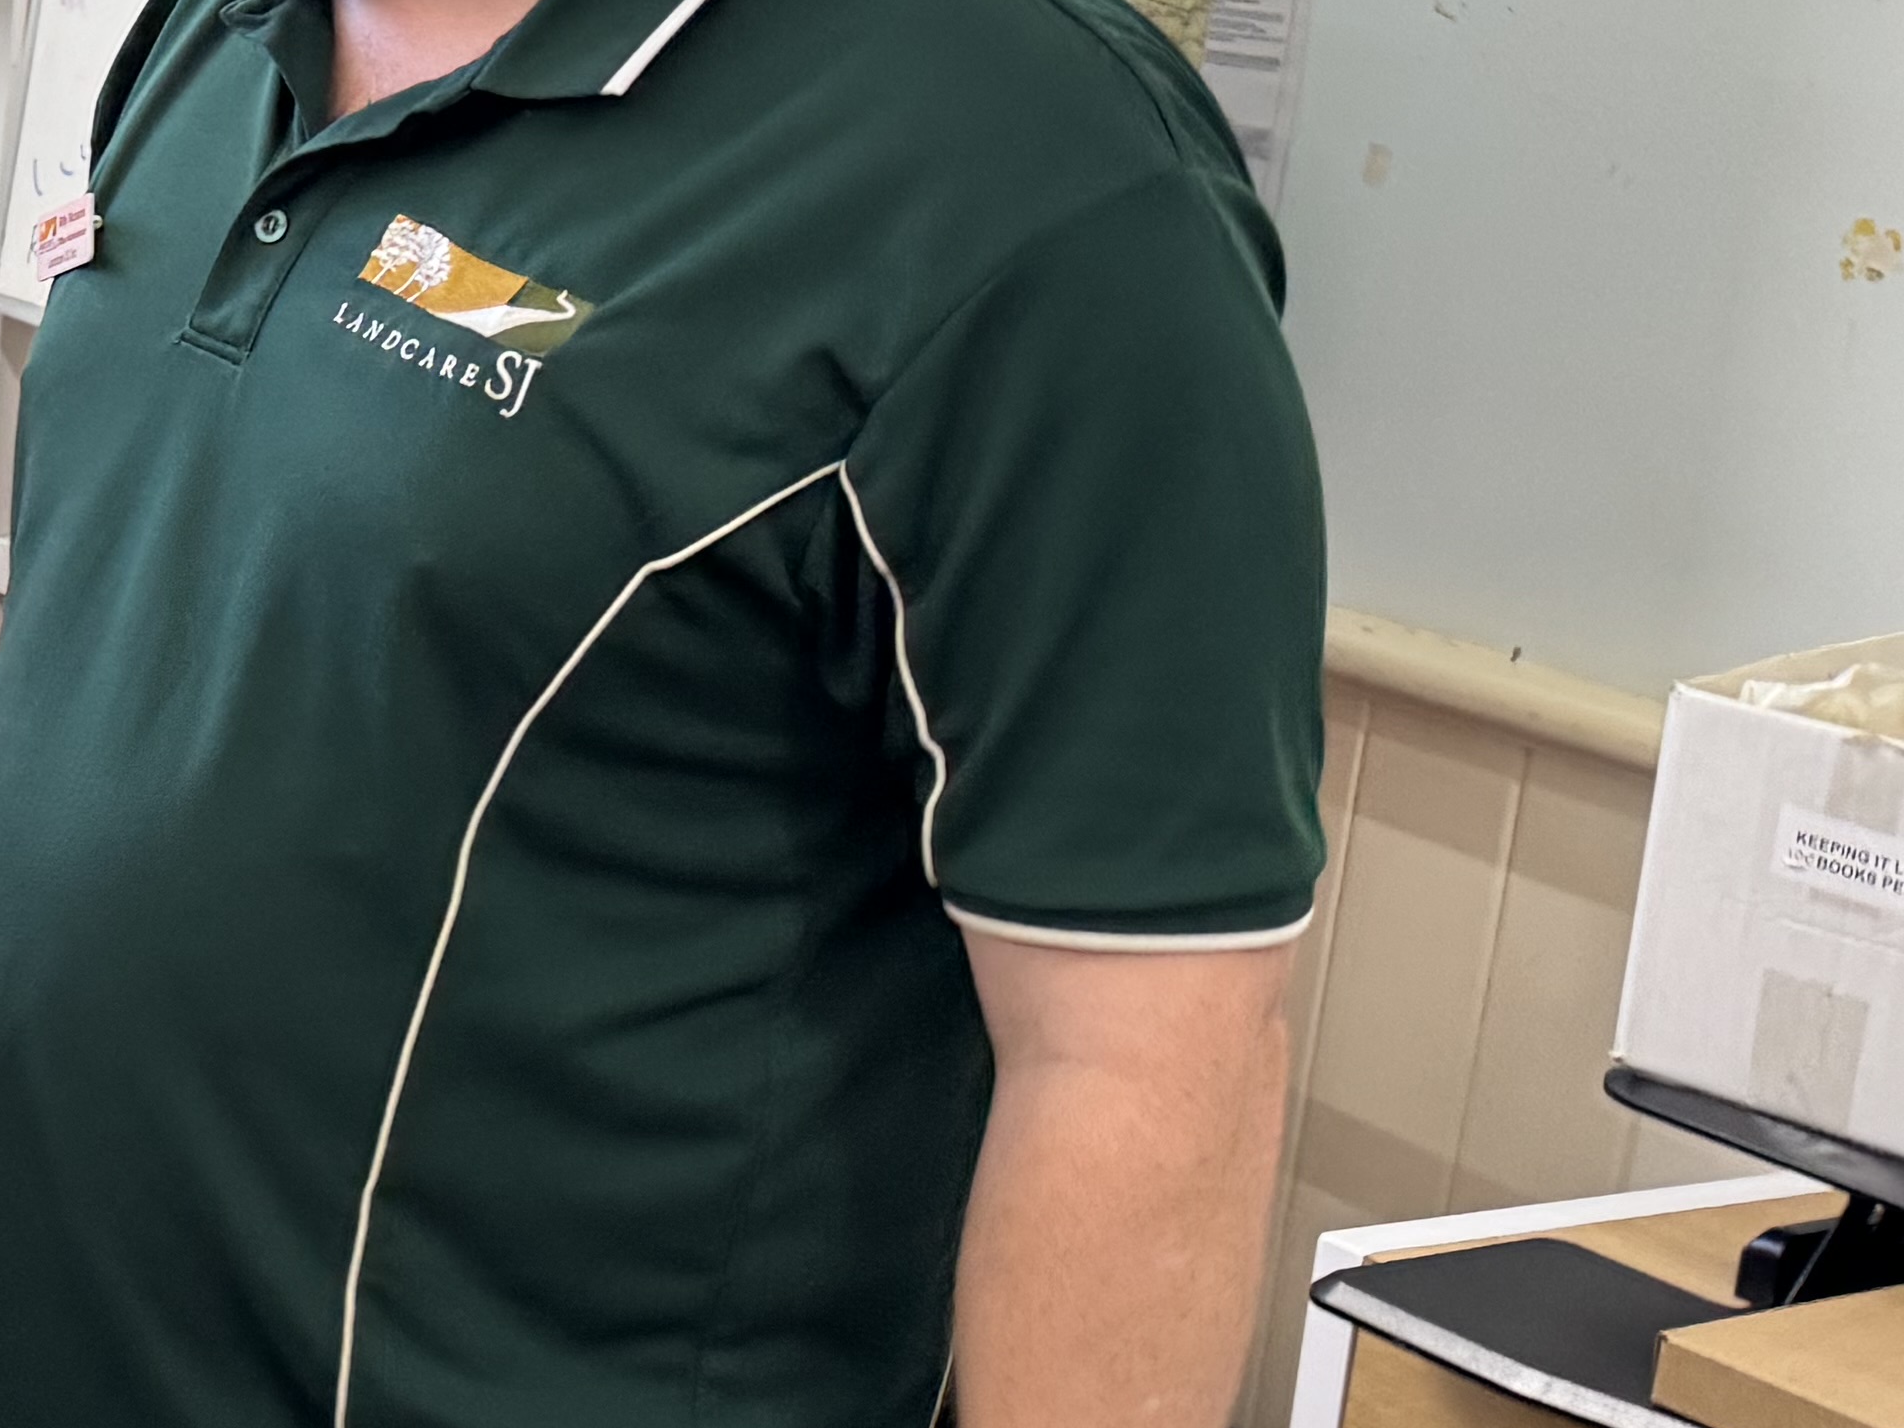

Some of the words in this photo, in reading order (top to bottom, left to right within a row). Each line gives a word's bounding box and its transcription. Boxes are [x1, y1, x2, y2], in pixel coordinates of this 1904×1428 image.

[332, 302, 481, 388] LANDCARE
[483, 350, 544, 418] SJ
[1795, 830, 1871, 865] KEEPING
[1875, 854, 1892, 872] IT
[1816, 855, 1878, 886] BOOKS
